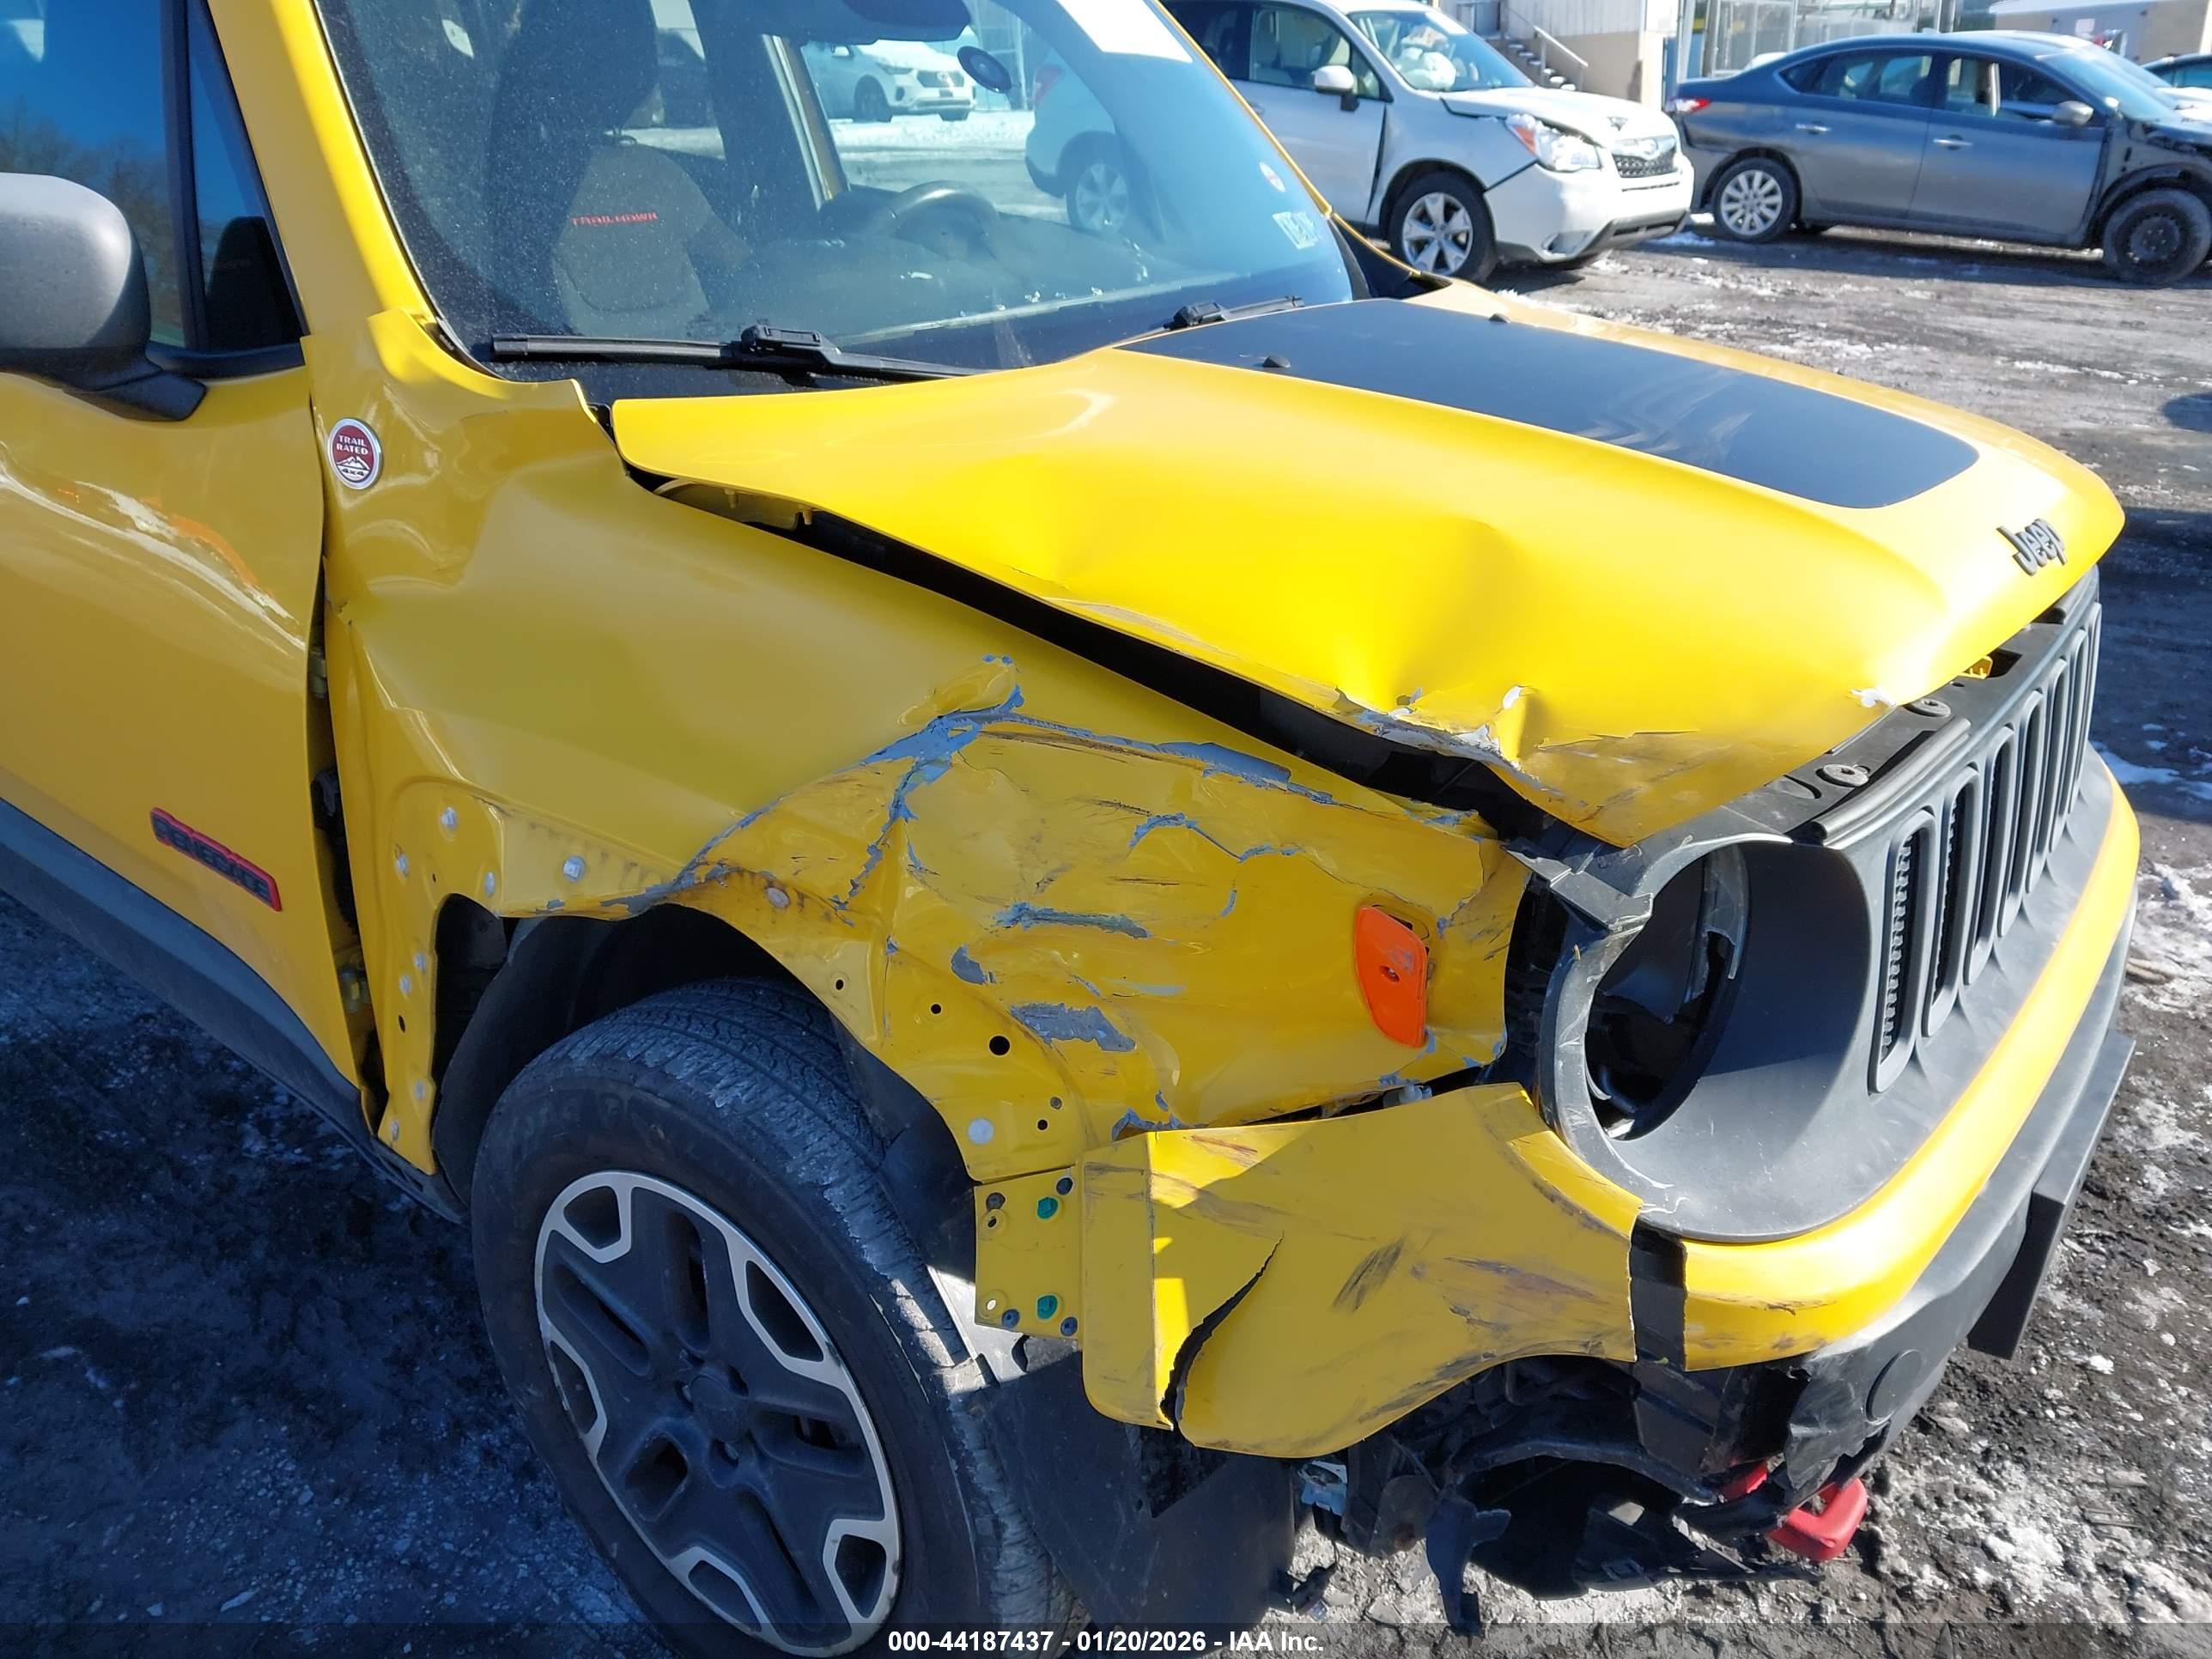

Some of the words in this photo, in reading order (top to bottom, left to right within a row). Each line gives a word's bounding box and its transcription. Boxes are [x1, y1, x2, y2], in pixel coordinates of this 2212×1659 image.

[338, 434, 367, 447] TRAIL
[336, 442, 368, 455] RATED
[1996, 518, 2068, 577] Jeep
